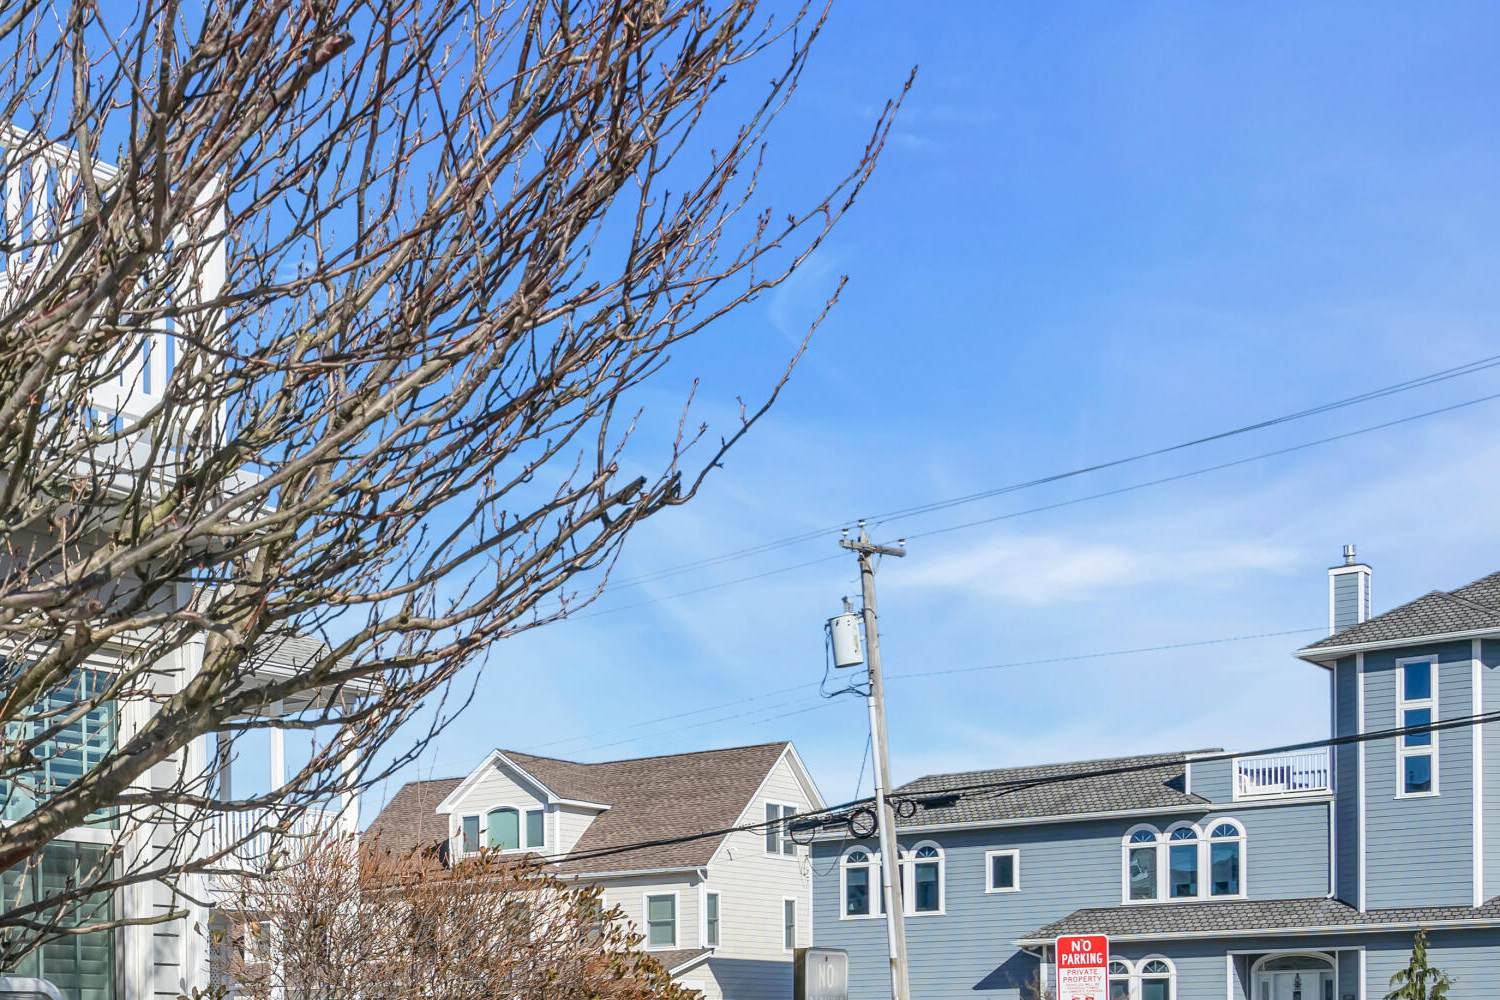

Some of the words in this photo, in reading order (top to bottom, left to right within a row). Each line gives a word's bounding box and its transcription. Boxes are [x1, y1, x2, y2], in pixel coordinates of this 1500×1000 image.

[1071, 940, 1092, 952] NO
[1061, 953, 1103, 965] PARKING
[819, 963, 834, 989] NO
